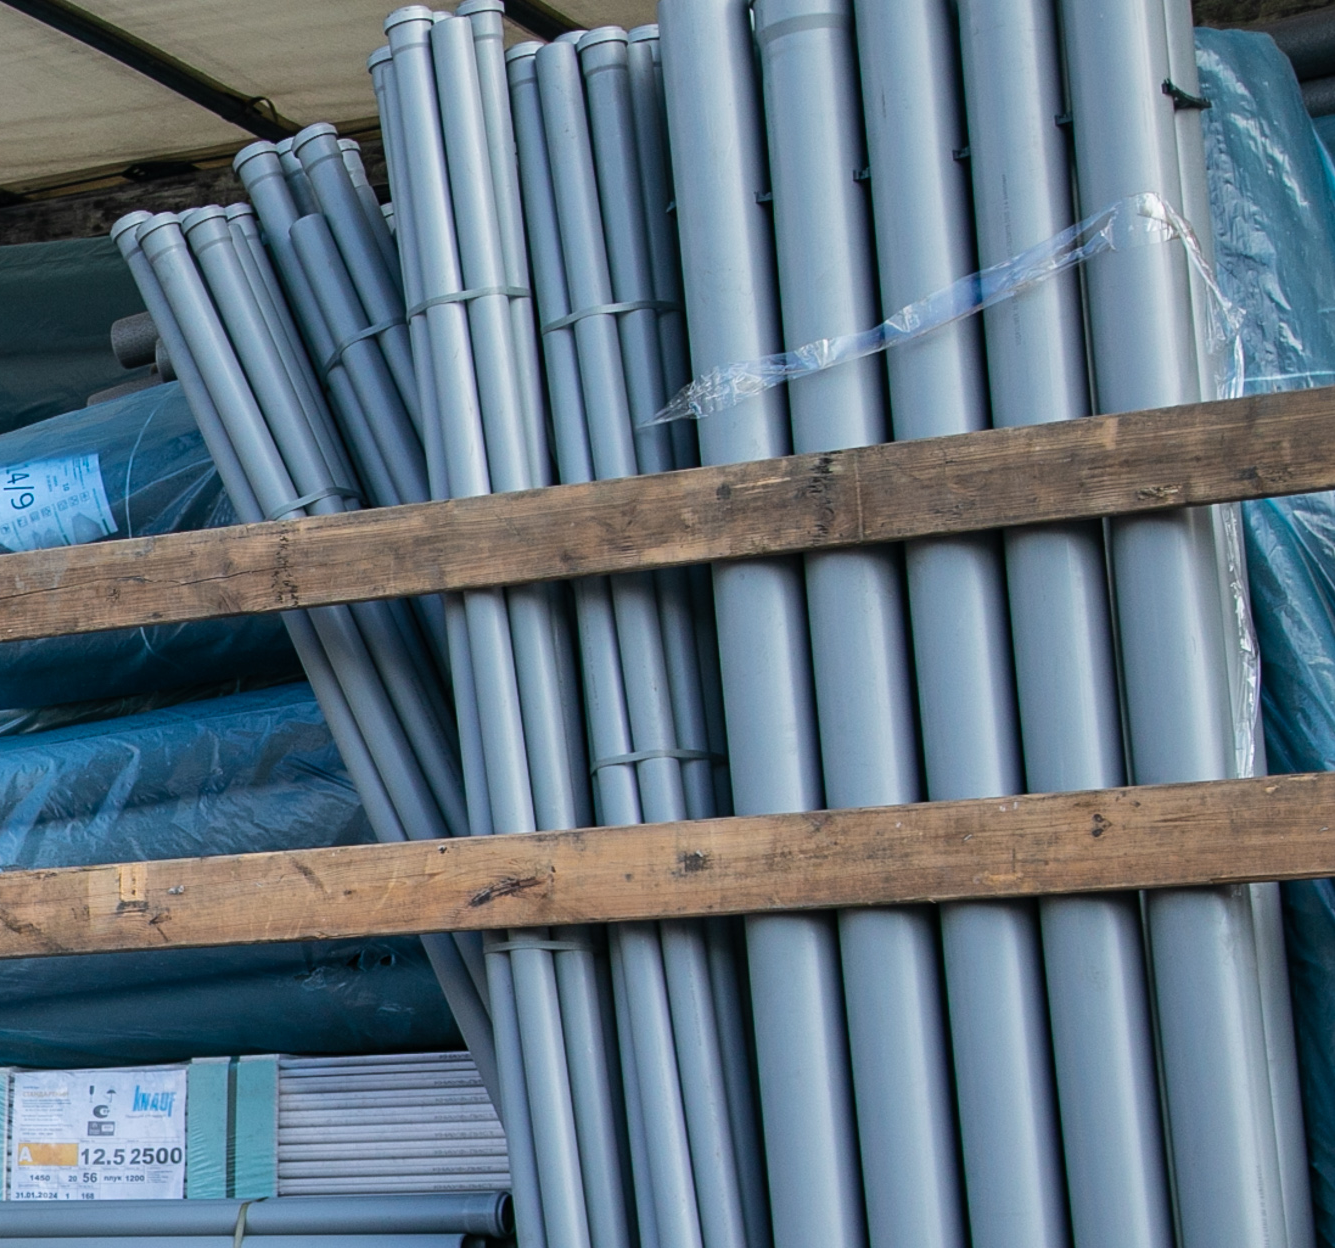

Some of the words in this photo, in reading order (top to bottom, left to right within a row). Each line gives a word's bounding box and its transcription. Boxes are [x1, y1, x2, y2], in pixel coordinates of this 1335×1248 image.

[132, 1085, 177, 1117] KNAUF
[81, 1148, 125, 1165] 12.5
[130, 1147, 182, 1164] 2500
[83, 1173, 97, 1182] 56
